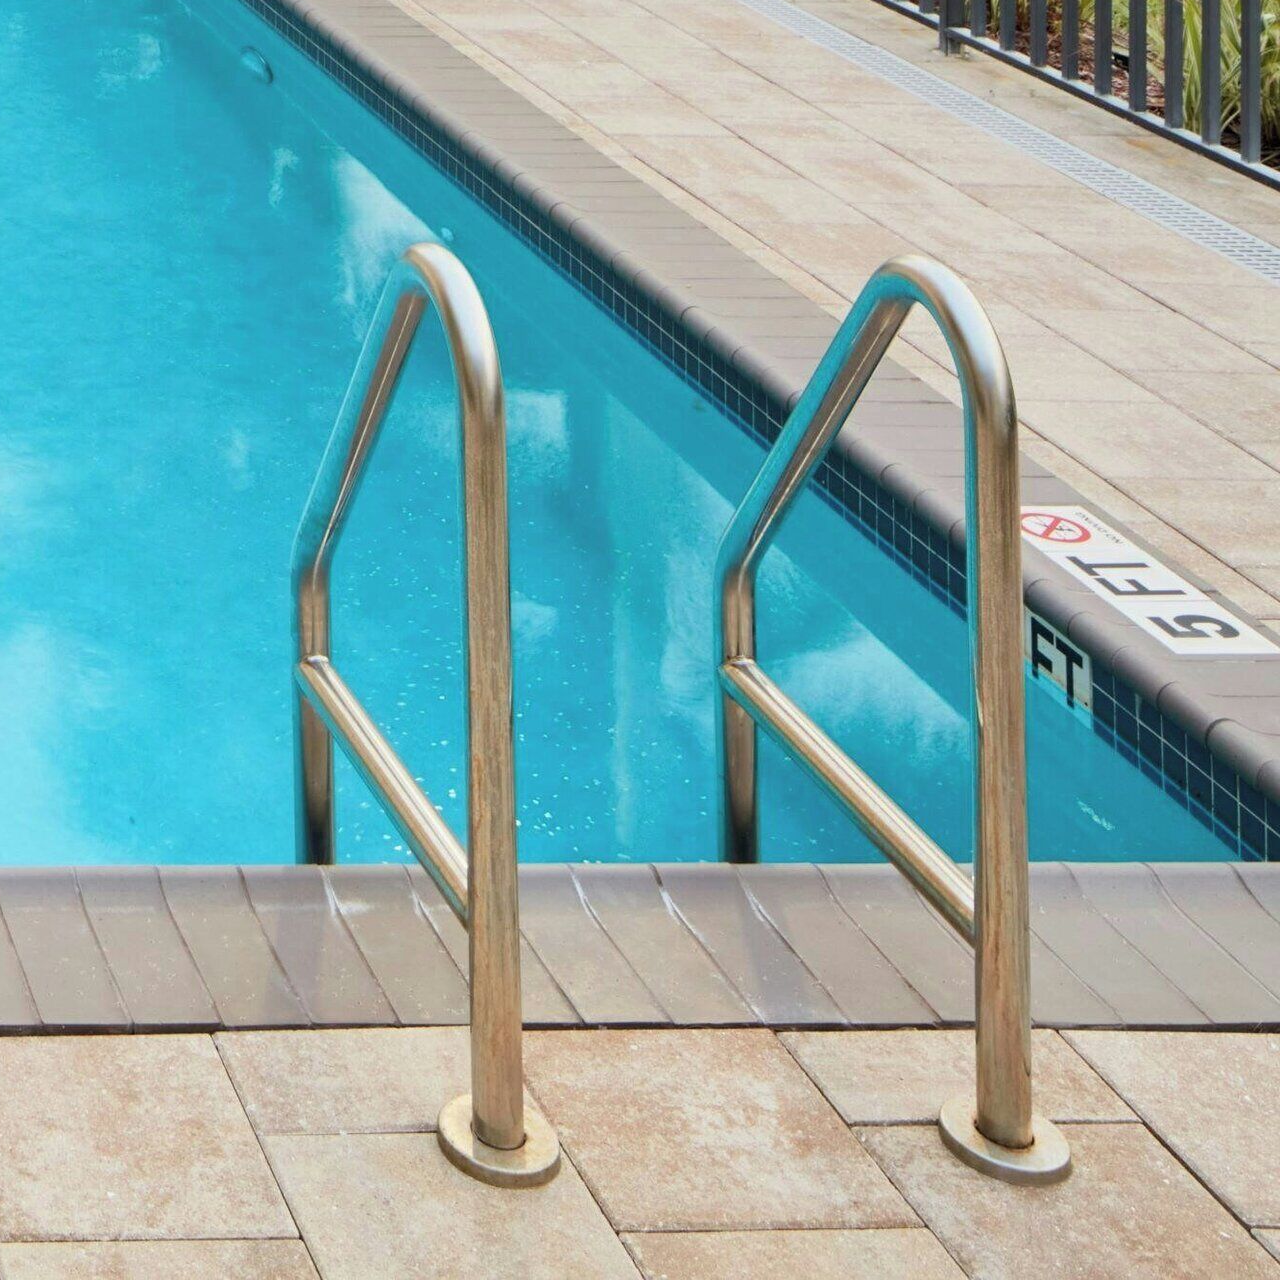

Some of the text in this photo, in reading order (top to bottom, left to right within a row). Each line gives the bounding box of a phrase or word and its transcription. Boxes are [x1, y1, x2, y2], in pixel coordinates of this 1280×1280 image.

[1066, 556, 1240, 639] 5 FT
[1031, 616, 1083, 709] FT
